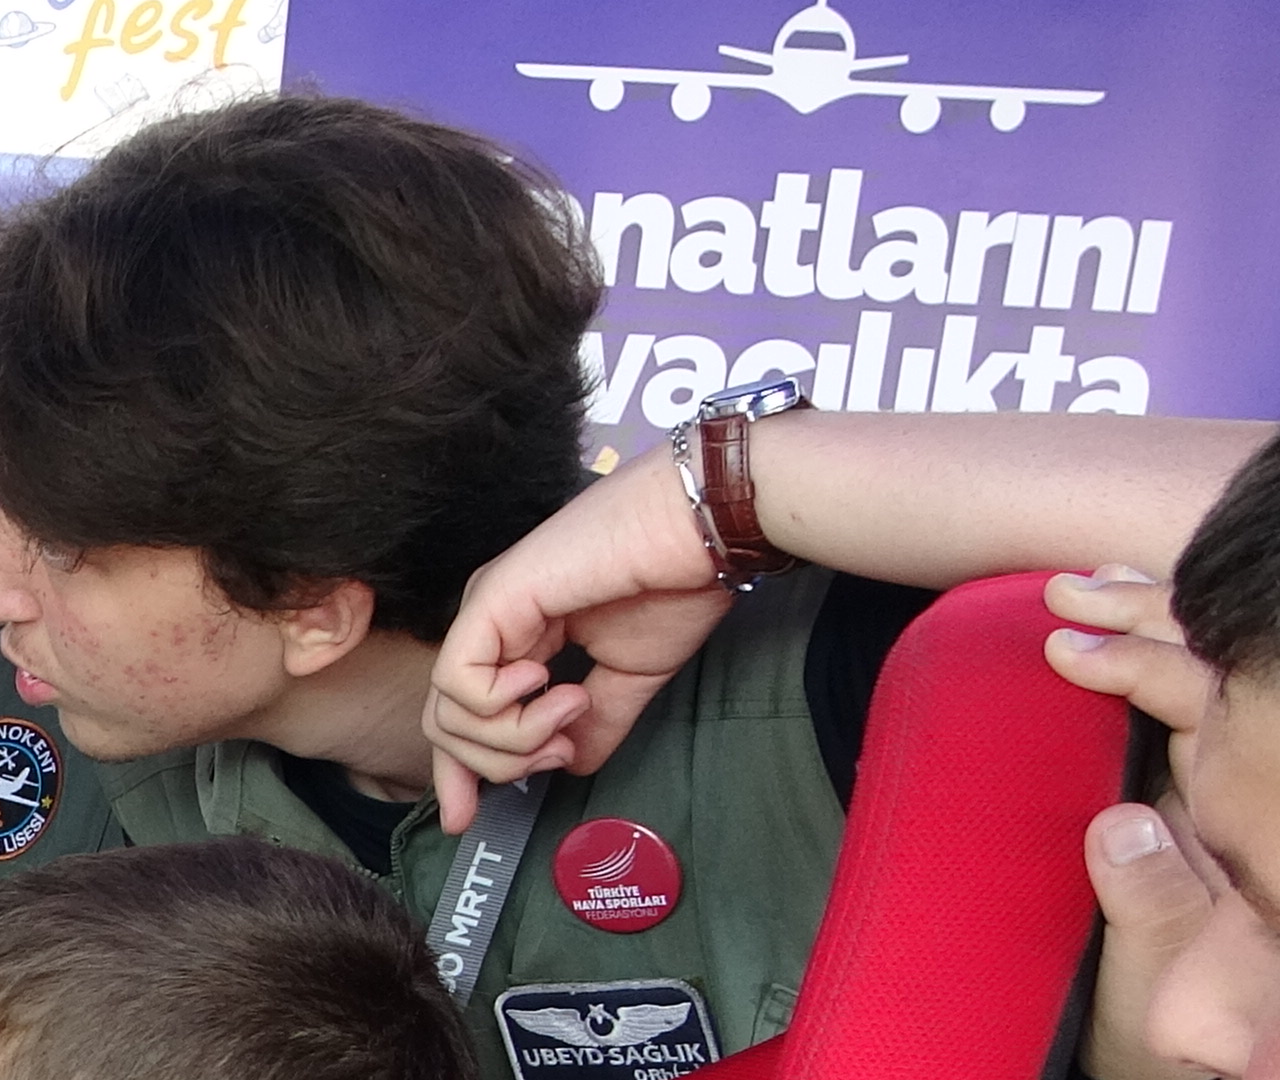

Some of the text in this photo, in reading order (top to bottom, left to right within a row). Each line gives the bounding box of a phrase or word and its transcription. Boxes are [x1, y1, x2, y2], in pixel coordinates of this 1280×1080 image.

[60, 0, 246, 101] fest
[444, 841, 502, 947] MRTT
[587, 884, 640, 899] TÜRKİYE
[572, 895, 667, 911] HAVA SPORLARI
[585, 907, 659, 921] FEDERASYONU
